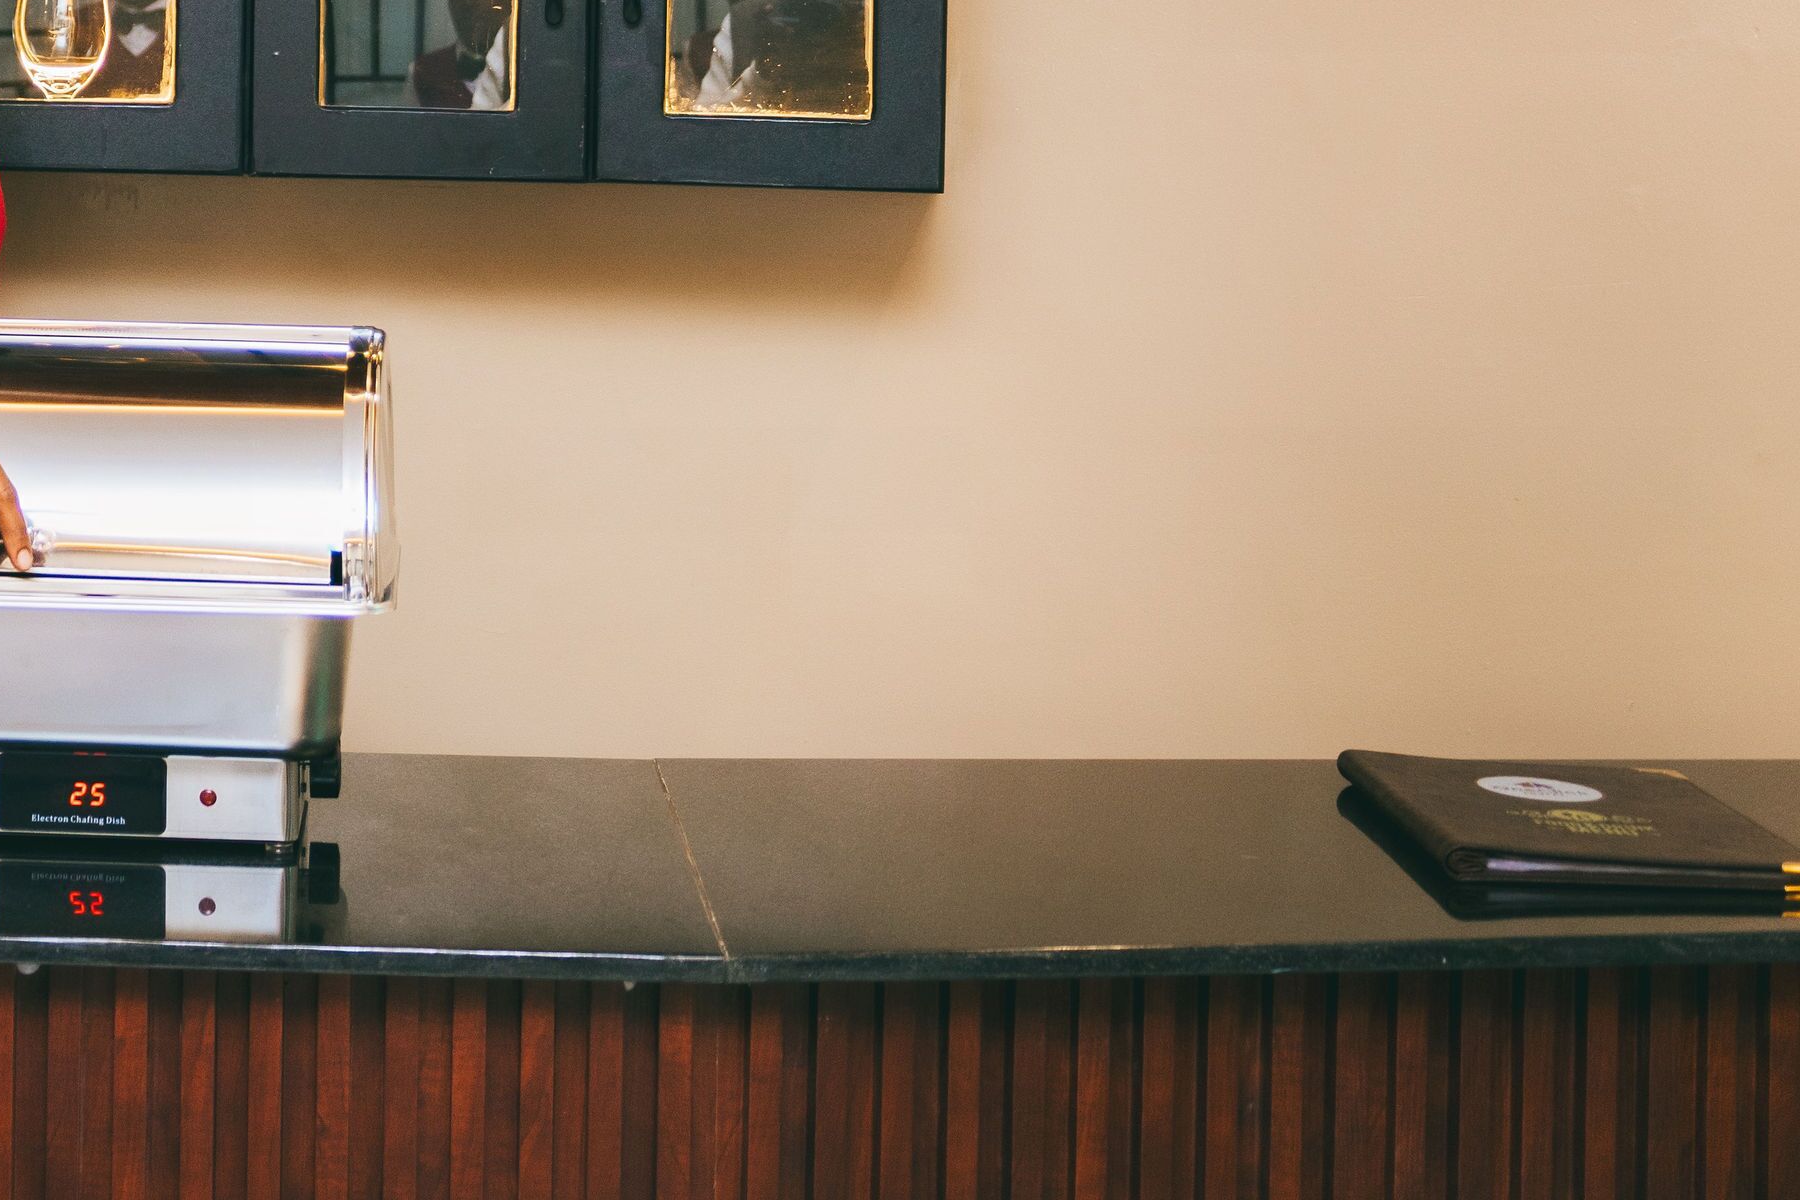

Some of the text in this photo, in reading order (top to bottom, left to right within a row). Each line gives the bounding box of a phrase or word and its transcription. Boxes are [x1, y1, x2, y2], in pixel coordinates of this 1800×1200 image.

[69, 781, 105, 807] 25
[31, 813, 126, 826] Electron Chafing Dish
